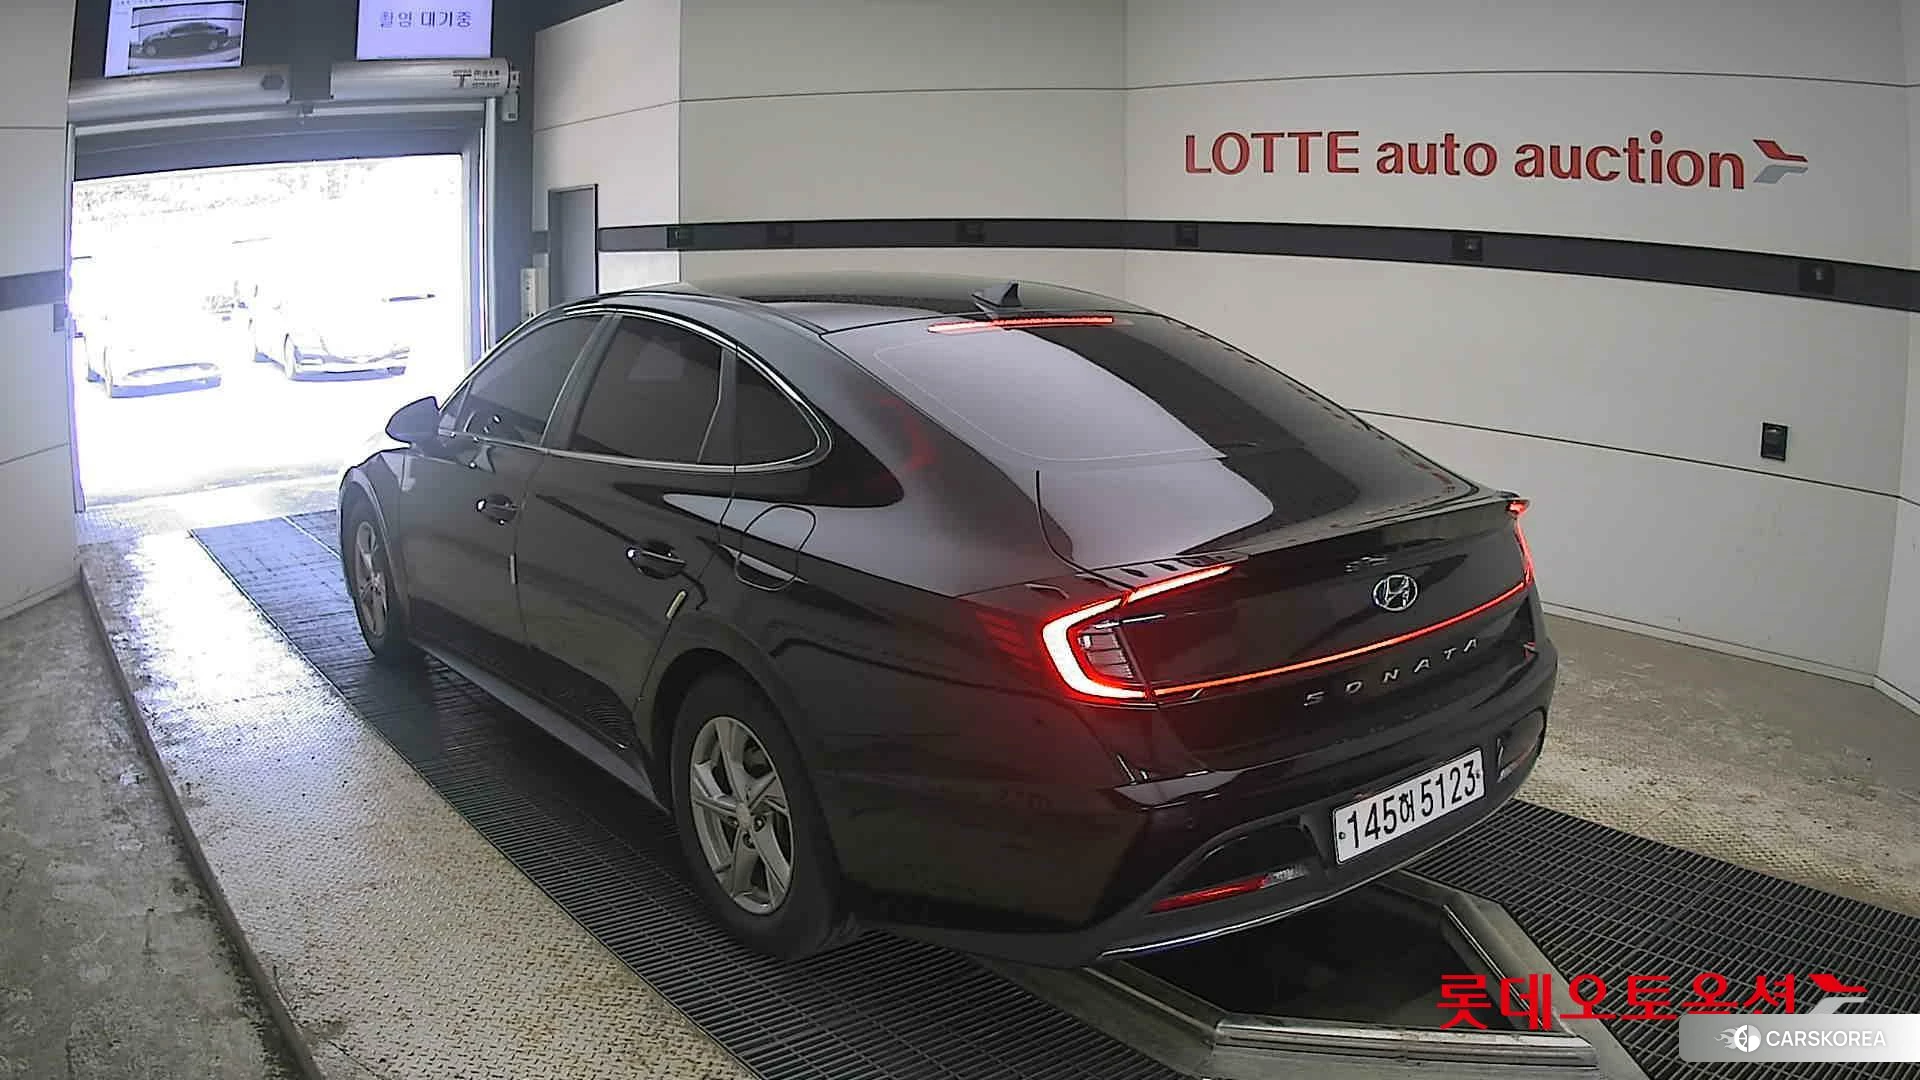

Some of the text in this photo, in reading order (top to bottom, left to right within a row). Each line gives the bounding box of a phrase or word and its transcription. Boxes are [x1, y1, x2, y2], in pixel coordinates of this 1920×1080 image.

[421, 10, 472, 28] 대기중
[1185, 130, 1745, 189] LOTTE auto auction
[1303, 638, 1478, 706] SONATA
